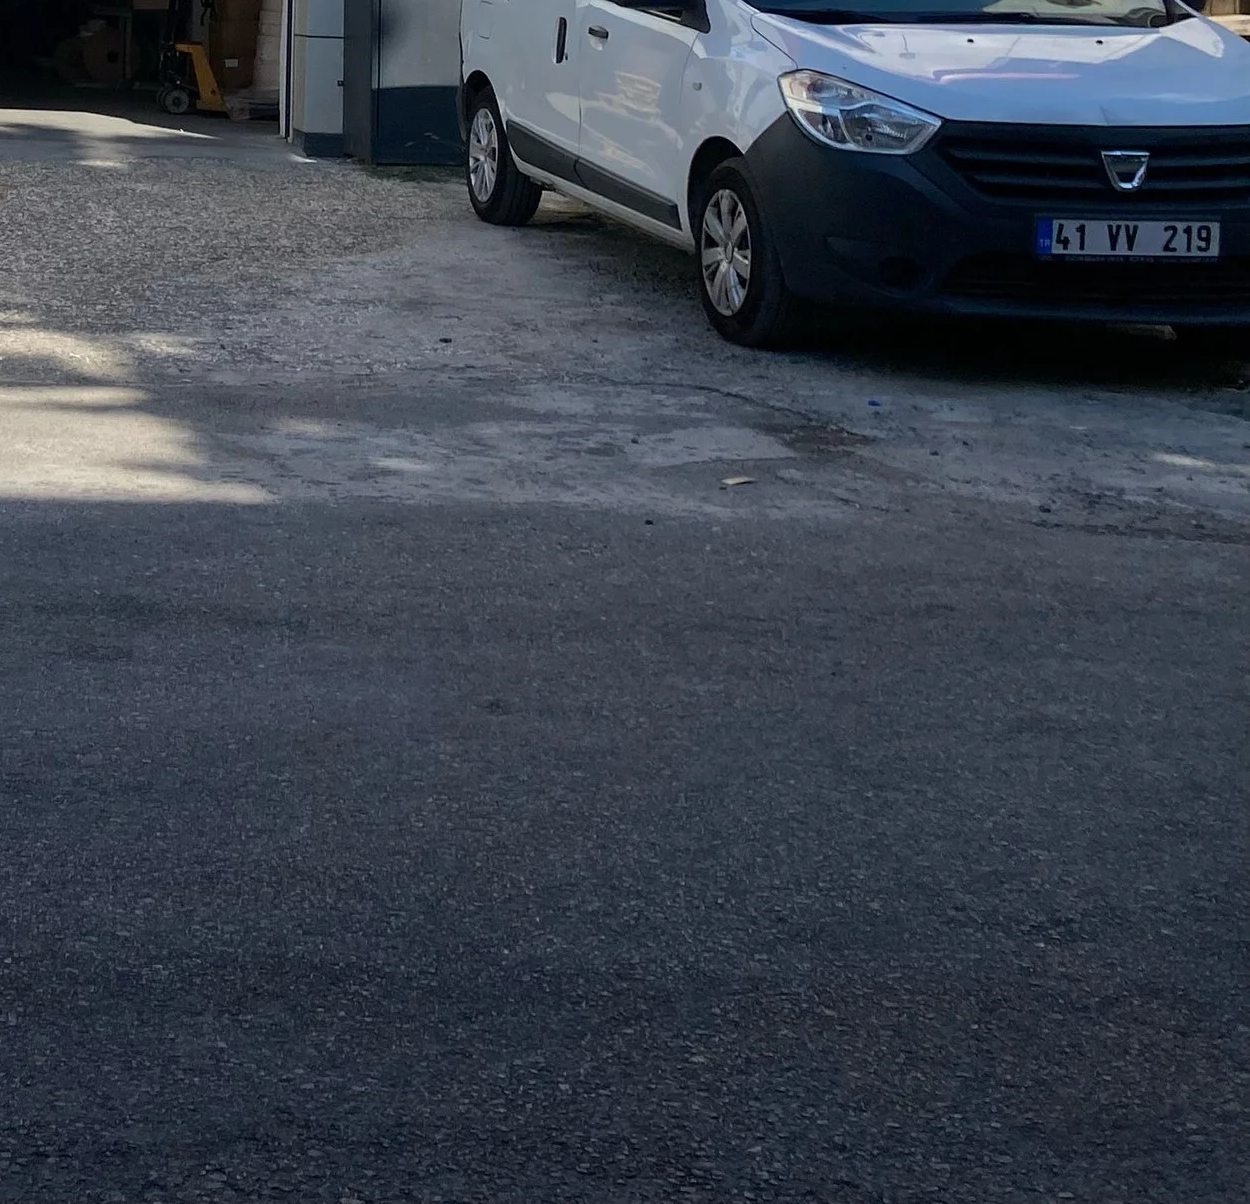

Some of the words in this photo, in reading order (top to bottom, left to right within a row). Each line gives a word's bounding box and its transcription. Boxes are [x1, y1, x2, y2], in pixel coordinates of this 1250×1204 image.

[1055, 223, 1086, 251] 41
[1107, 224, 1139, 252] VV
[1163, 225, 1212, 253] 219
